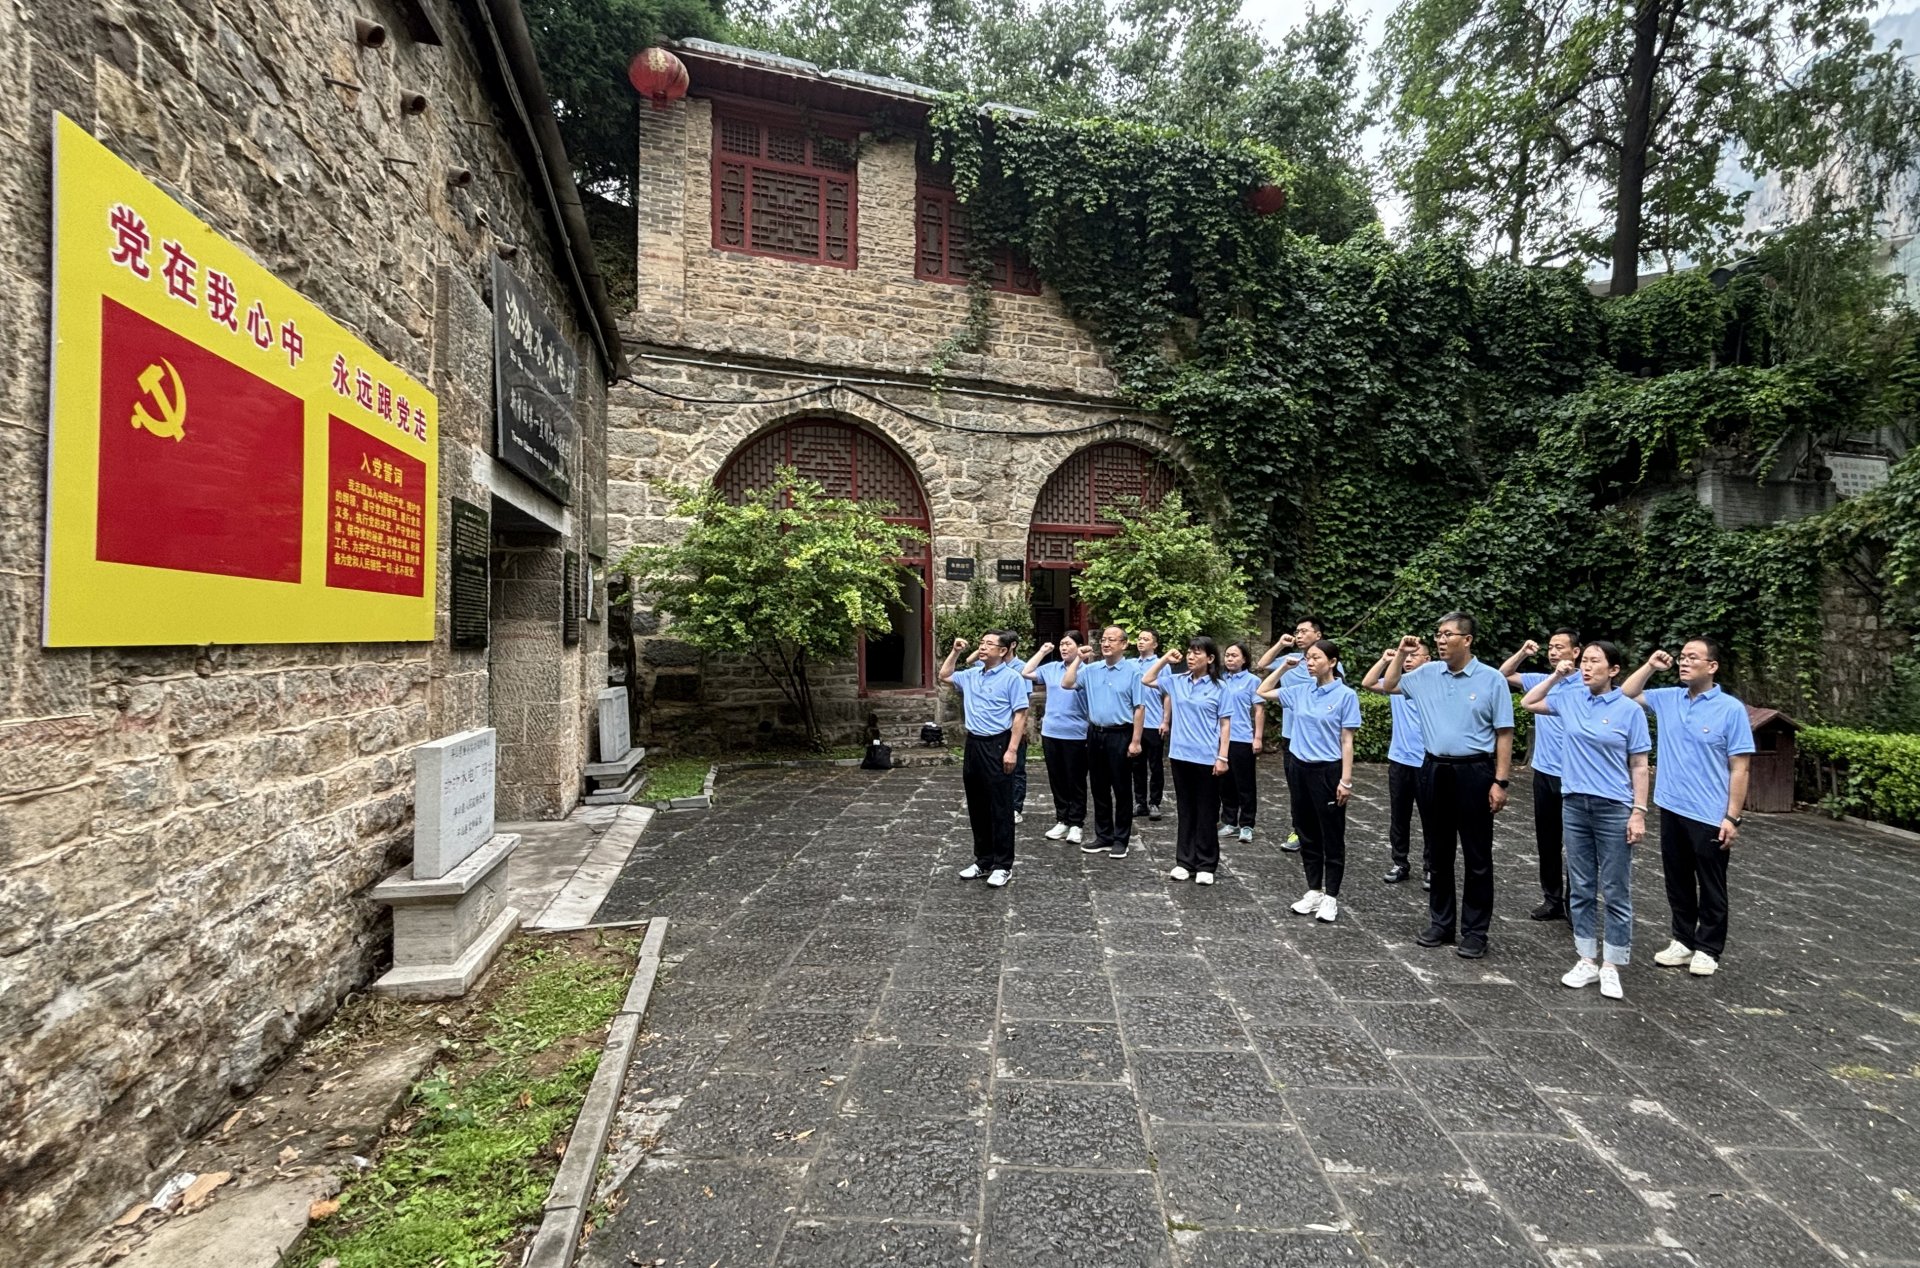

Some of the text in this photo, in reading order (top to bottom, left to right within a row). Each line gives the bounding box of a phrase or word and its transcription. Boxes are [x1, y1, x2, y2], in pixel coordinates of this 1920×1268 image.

[110, 206, 304, 367] 党在我心中
[332, 354, 428, 442] 永远跟党走
[361, 452, 403, 487] 入党誓词
